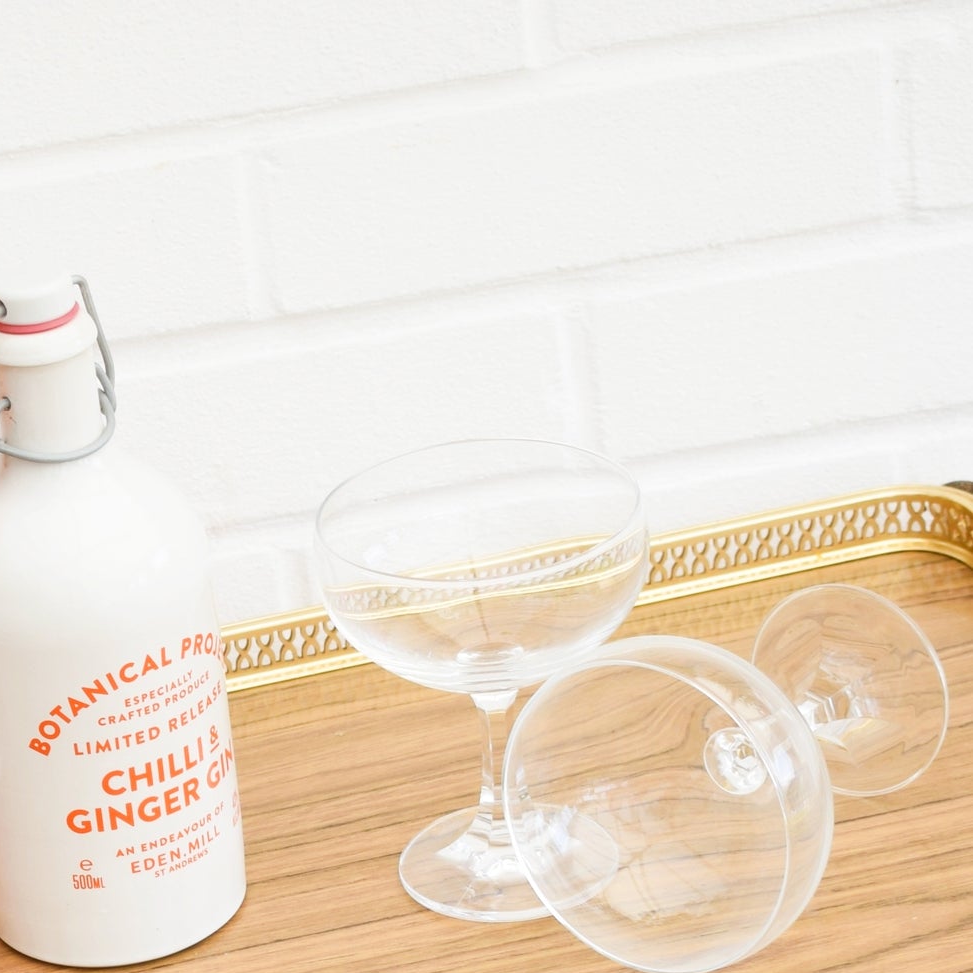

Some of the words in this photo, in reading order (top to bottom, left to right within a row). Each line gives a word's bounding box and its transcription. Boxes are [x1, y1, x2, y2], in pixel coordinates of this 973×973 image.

[29, 647, 172, 756] BOTANICAL
[98, 703, 160, 726] CRAFTED
[165, 671, 210, 707] PRODUCE
[124, 670, 193, 707] ESPECIALLY
[73, 726, 160, 756] LIMITED
[169, 680, 222, 732] RELEASE
[102, 737, 204, 796] CHILLI
[209, 725, 219, 747] &
[66, 777, 200, 834] GINGER
[116, 845, 135, 858] AN
[141, 813, 212, 852] ENDEAVOUR
[215, 801, 224, 817] OF
[155, 867, 166, 878] ST
[169, 849, 209, 873] ANDREWS
